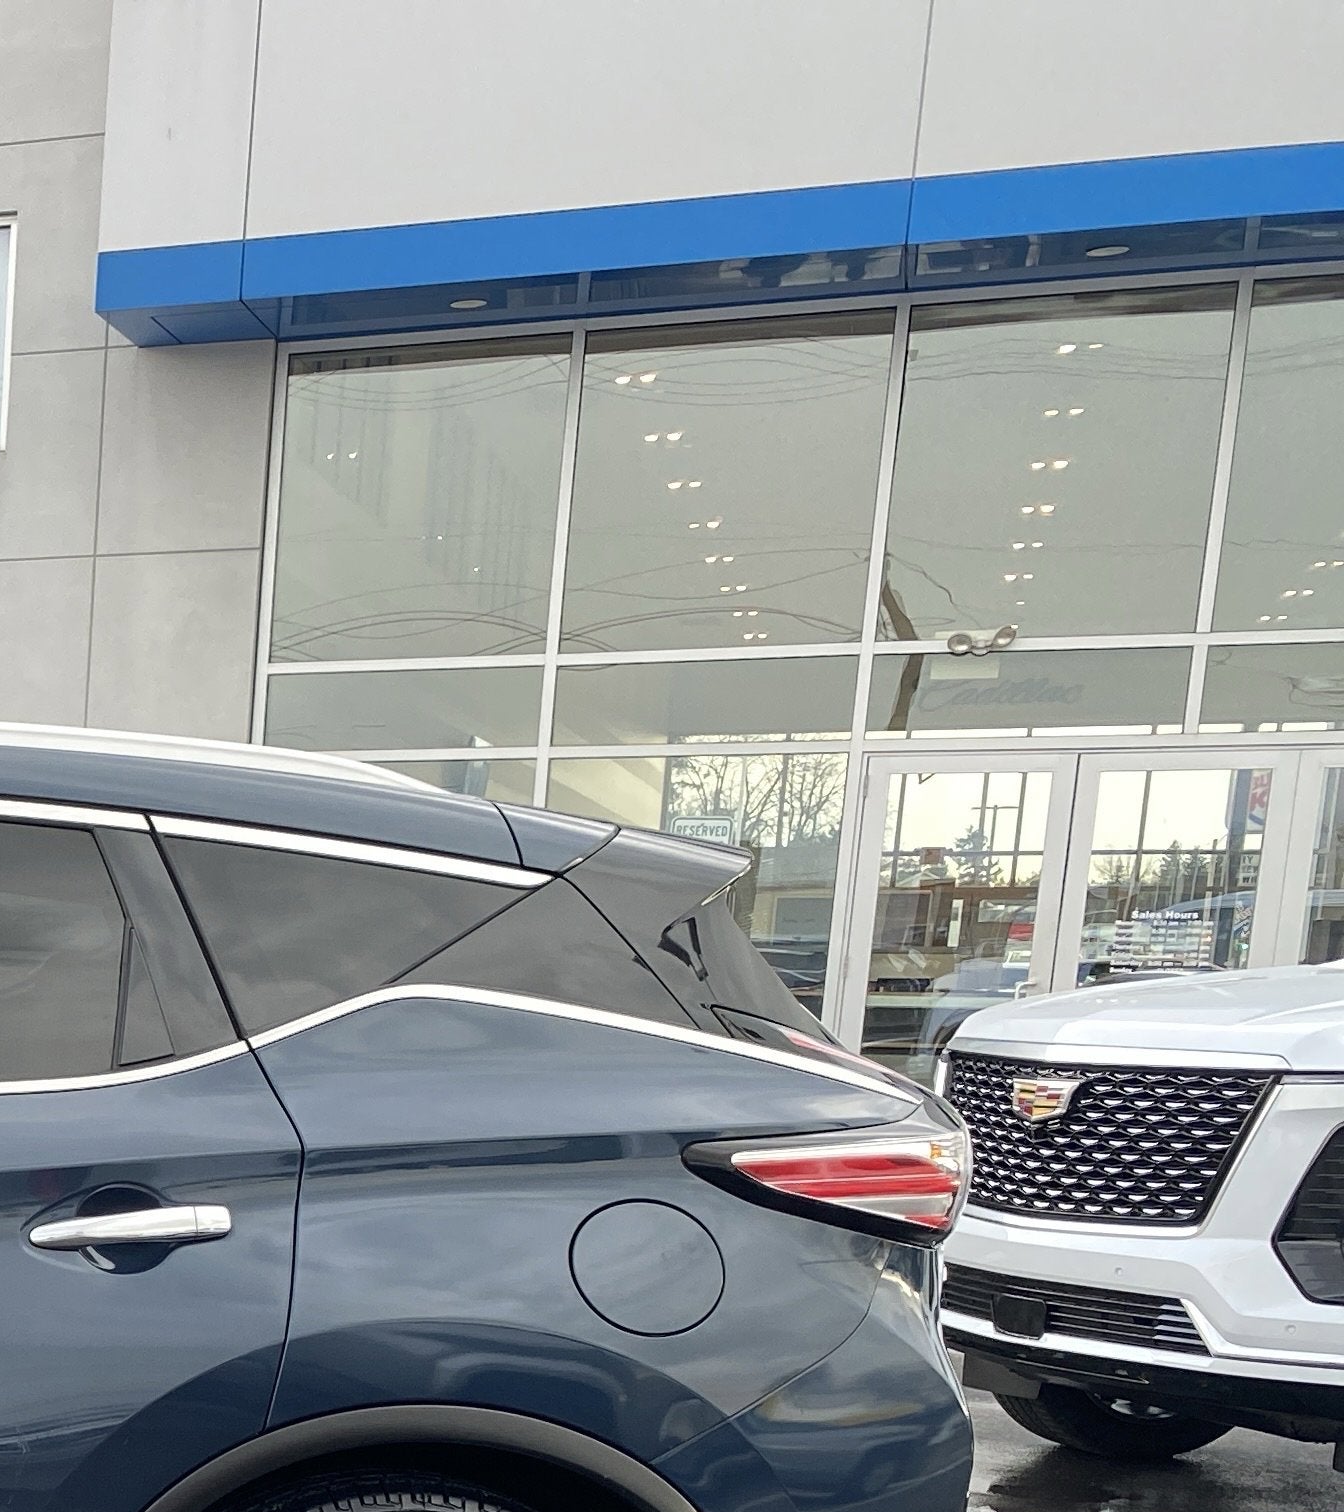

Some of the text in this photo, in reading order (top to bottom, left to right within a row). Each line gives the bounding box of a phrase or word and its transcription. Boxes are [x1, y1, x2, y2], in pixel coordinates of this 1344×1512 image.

[676, 825, 728, 837] RESERVED
[1131, 911, 1199, 919] Sales Hours
